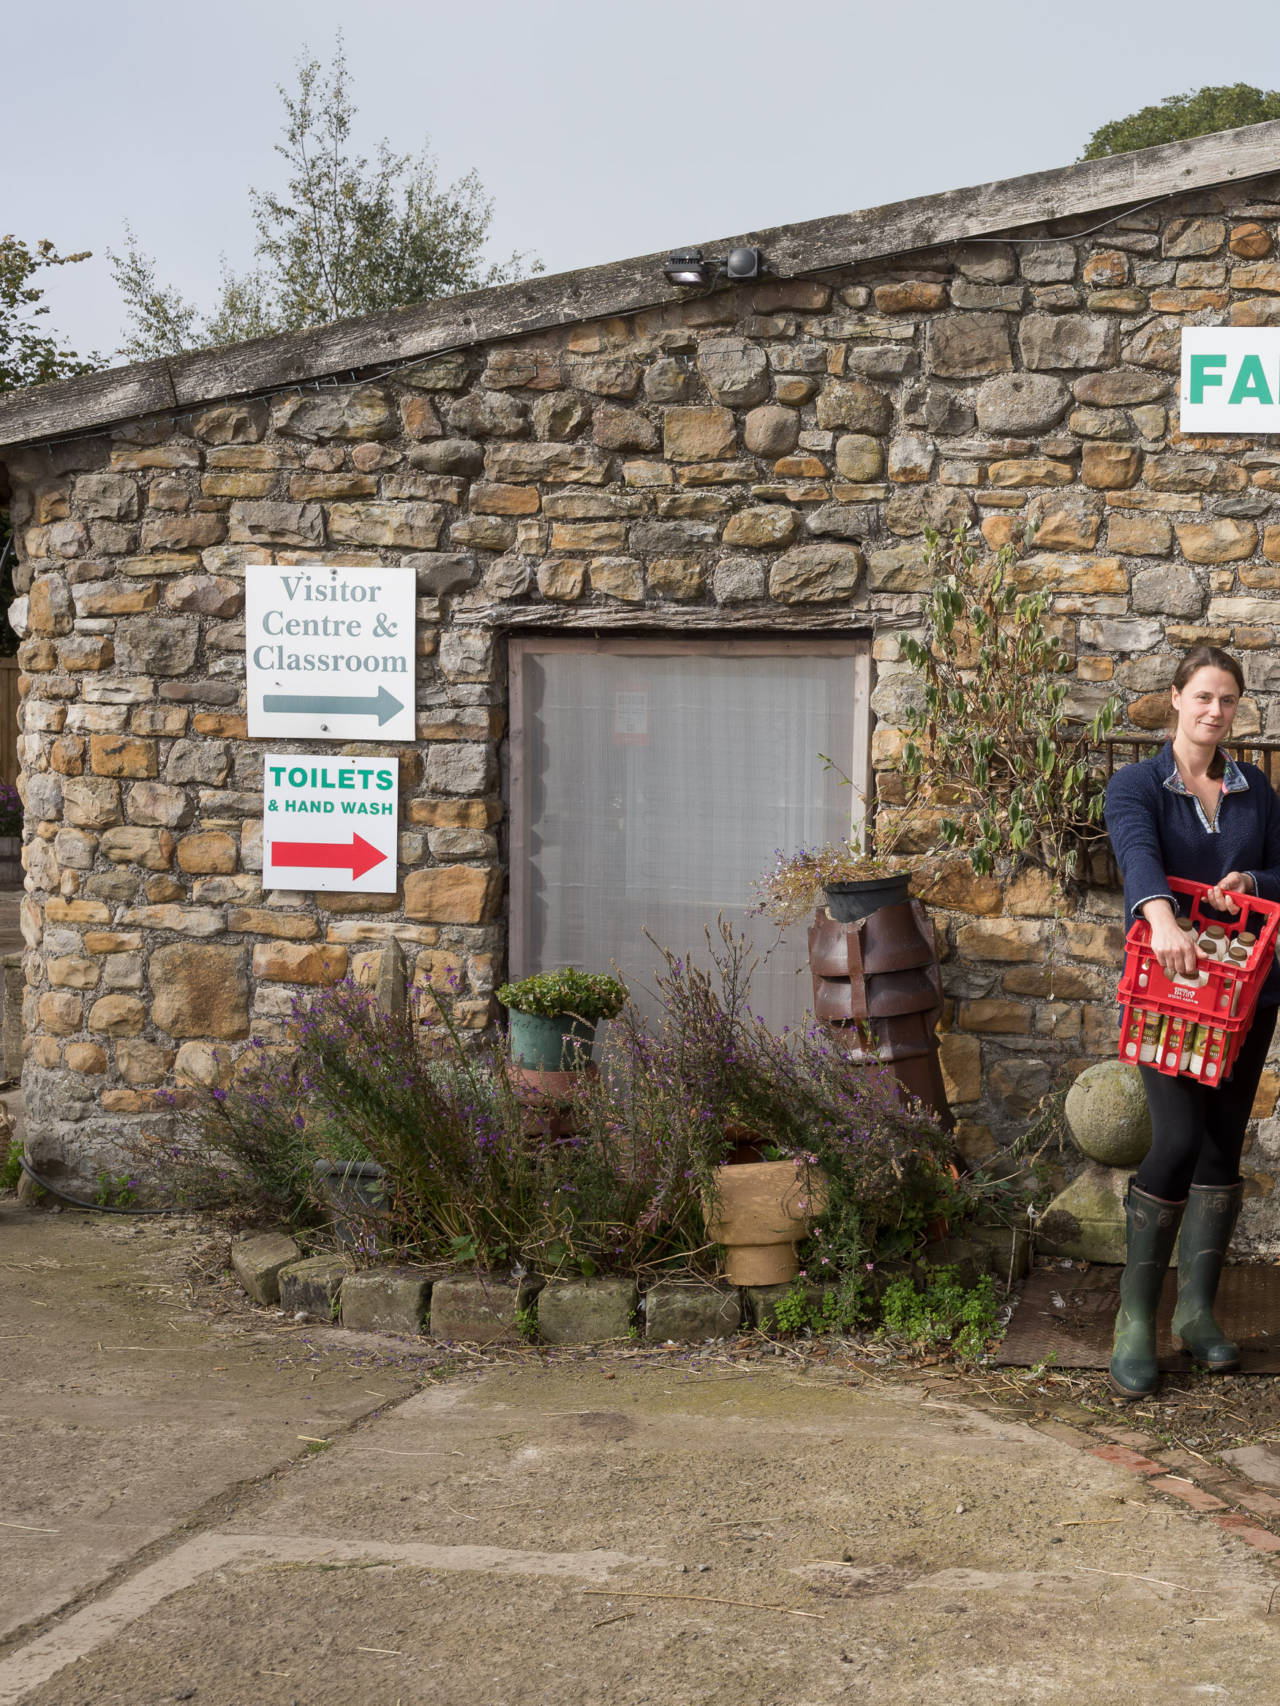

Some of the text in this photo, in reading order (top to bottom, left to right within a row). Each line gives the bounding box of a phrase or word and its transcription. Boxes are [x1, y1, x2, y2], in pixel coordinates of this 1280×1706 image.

[279, 575, 382, 603] Visitor
[262, 610, 398, 638] Centre &
[252, 644, 409, 673] Classroom
[269, 766, 394, 791] TOILETS
[267, 799, 393, 815] & HAND WASH
